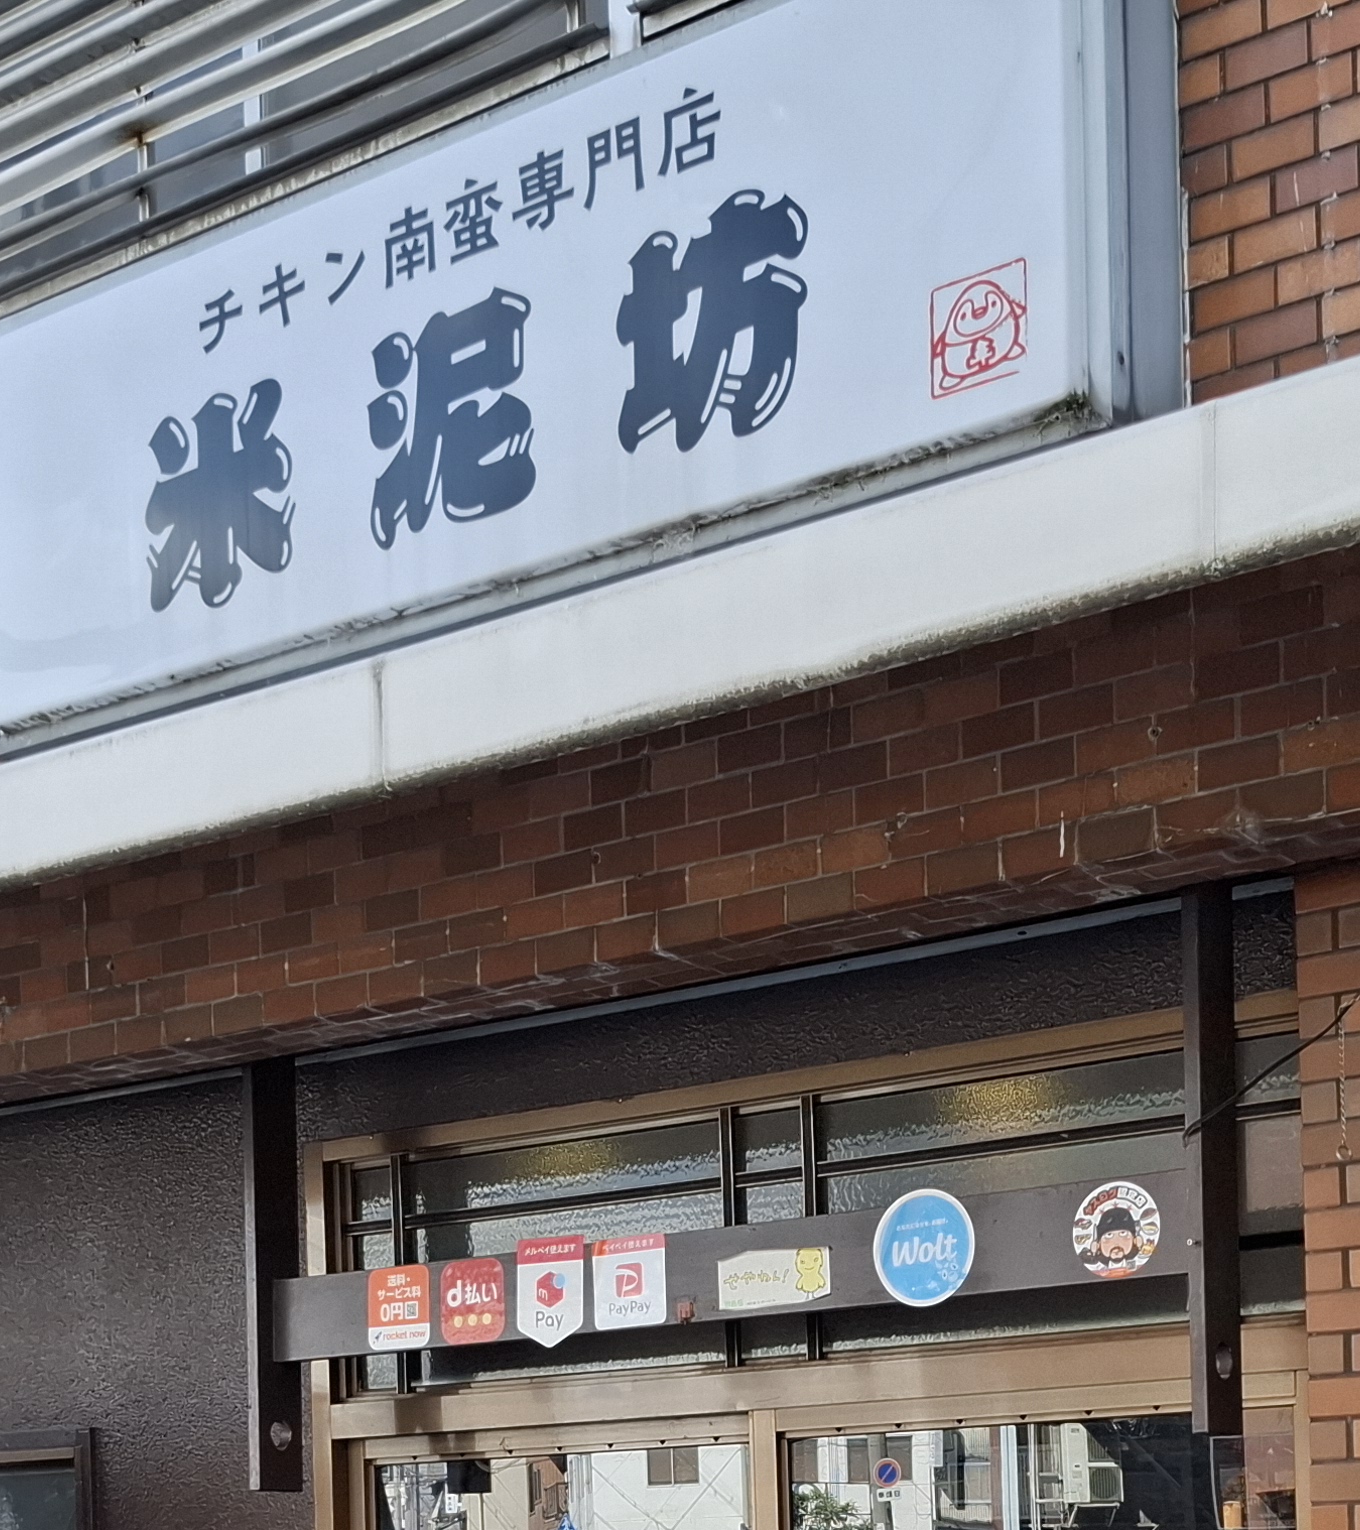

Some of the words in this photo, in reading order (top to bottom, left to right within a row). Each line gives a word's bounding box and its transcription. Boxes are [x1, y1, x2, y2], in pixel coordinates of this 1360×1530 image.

[197, 86, 723, 354] チキン南蛮専門店
[144, 187, 810, 613] 米泥坊
[890, 1232, 958, 1268] Wolt
[377, 1285, 422, 1301] サービス料
[446, 1279, 498, 1307] d払い
[380, 1302, 404, 1323] 0円
[608, 1300, 652, 1317] PayPay
[535, 1310, 564, 1331] Pay
[383, 1330, 408, 1341] rocket
[409, 1330, 427, 1339] now
